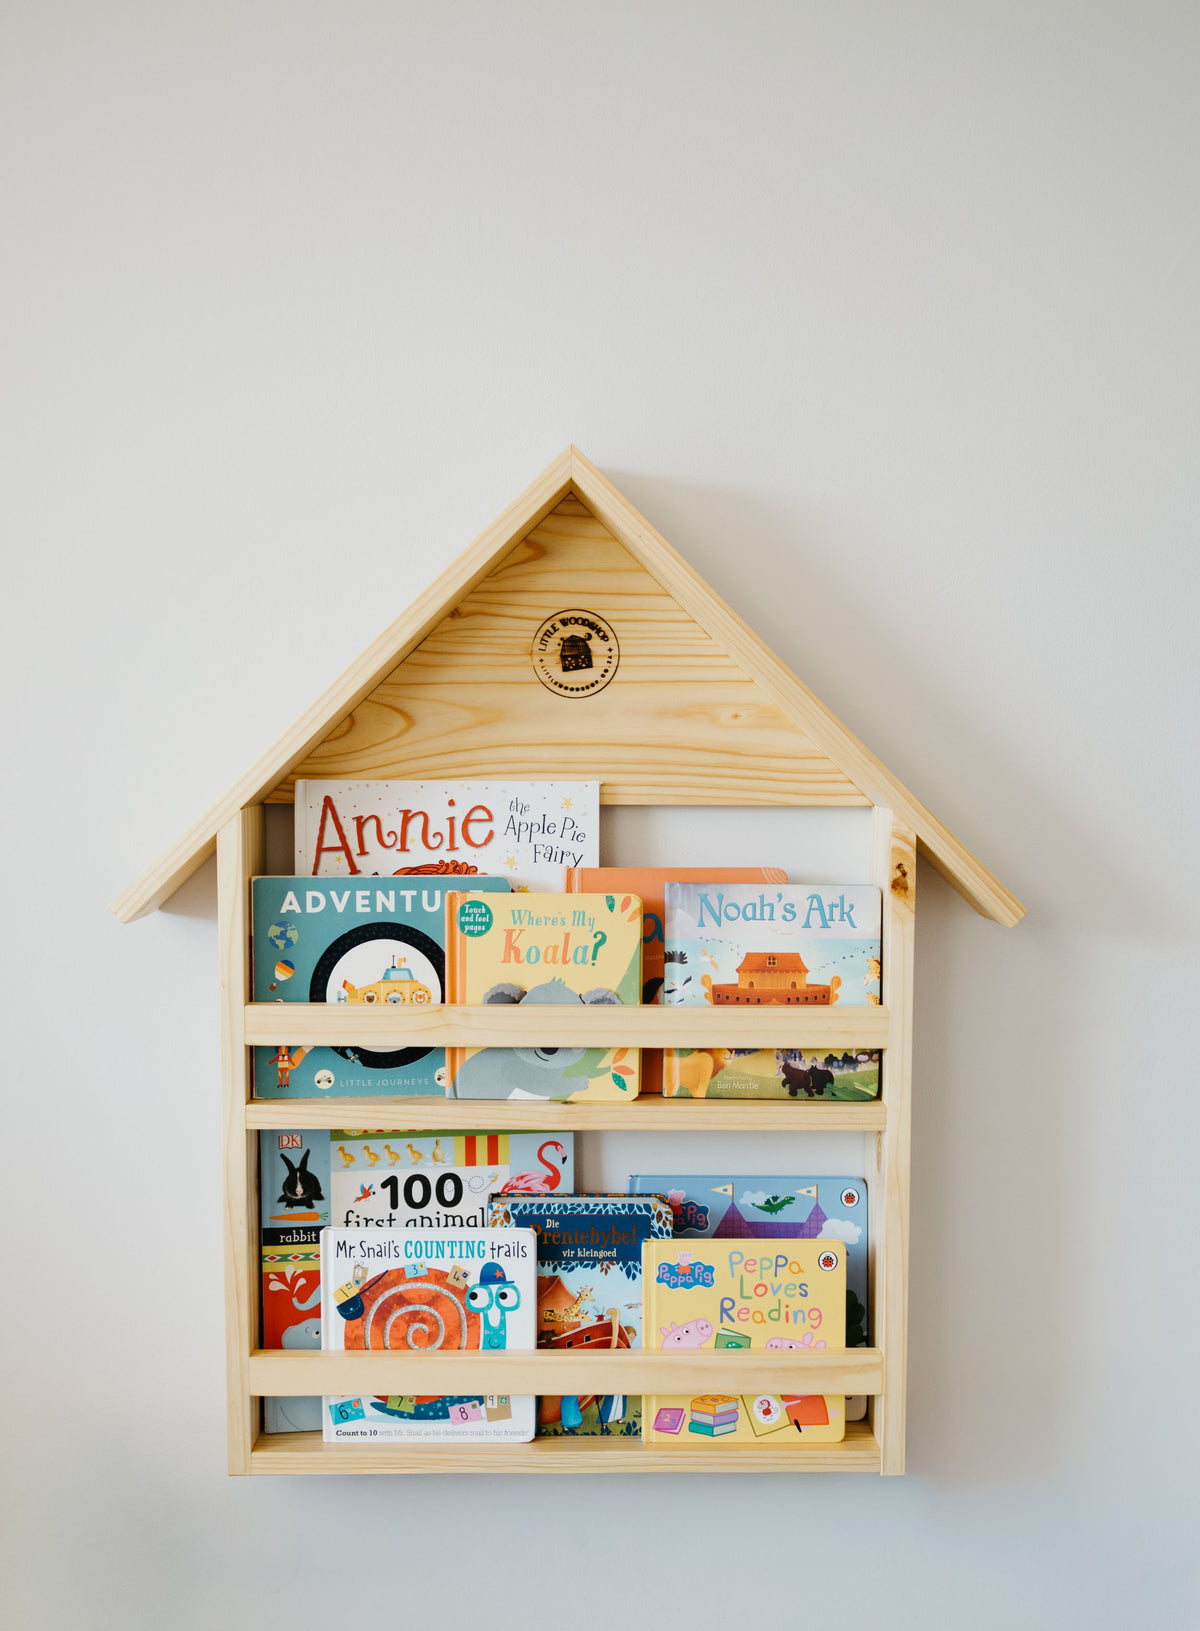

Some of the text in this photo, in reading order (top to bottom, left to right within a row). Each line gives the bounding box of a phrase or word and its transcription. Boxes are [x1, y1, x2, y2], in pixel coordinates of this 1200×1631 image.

[538, 616, 609, 652] LITTLE WOODSHOP
[509, 797, 530, 816] the
[312, 795, 495, 876] Annie
[503, 813, 586, 843] Apple Pie
[533, 843, 584, 868] Fairy
[280, 890, 484, 914] ADVENTU
[463, 904, 486, 914] Touch
[697, 892, 857, 929] Noah's Ark
[475, 914, 489, 922] feel
[510, 909, 595, 933] Where's My
[464, 923, 486, 933] pages
[500, 928, 607, 967] Koala?
[340, 1078, 429, 1087] LITTLE JOURNEYS
[717, 1080, 759, 1090] Ben Mantle
[280, 1134, 301, 1147] DK
[380, 1172, 463, 1210] 100
[343, 1209, 397, 1228] first
[545, 1219, 560, 1229] Die
[687, 1205, 707, 1228] Pig
[279, 1229, 317, 1243] rabbit
[530, 1223, 637, 1248] Prentebybel
[336, 1240, 528, 1259] Mr. Snail's COUNTING trails
[562, 1248, 617, 1259] vir kleingoed
[411, 1265, 418, 1276] 3
[728, 1250, 805, 1281] Peppa
[452, 1271, 461, 1283] 4
[659, 1264, 714, 1287] Peppa Pig
[740, 1274, 809, 1300] Loves
[719, 1296, 823, 1330] Reading
[338, 1405, 349, 1420] 6
[459, 1407, 469, 1420] 8
[442, 1429, 469, 1437] delivers
[470, 1429, 484, 1437] mail
[493, 1429, 503, 1437] his
